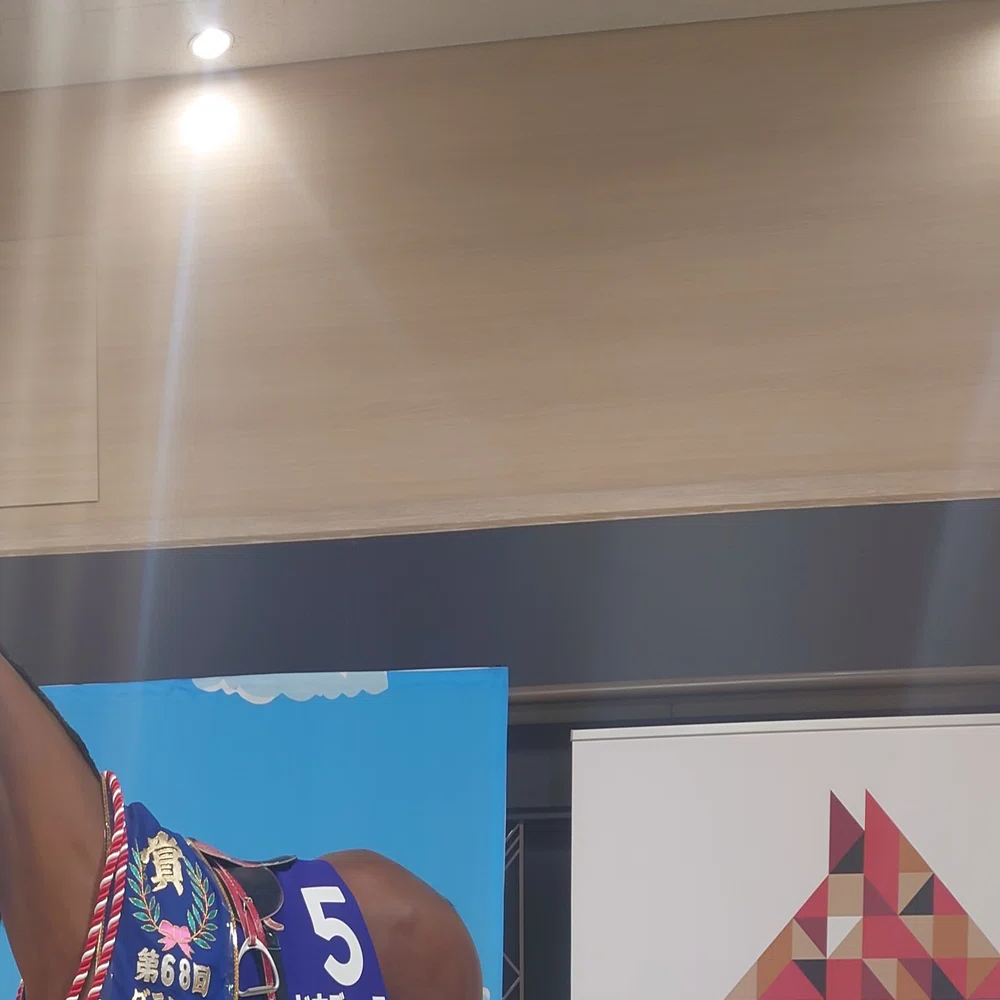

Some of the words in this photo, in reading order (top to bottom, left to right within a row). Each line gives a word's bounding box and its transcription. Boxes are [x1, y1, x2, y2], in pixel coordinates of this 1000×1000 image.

[140, 830, 184, 896] 賞
[301, 886, 364, 986] 5
[134, 946, 211, 998] 第68回
